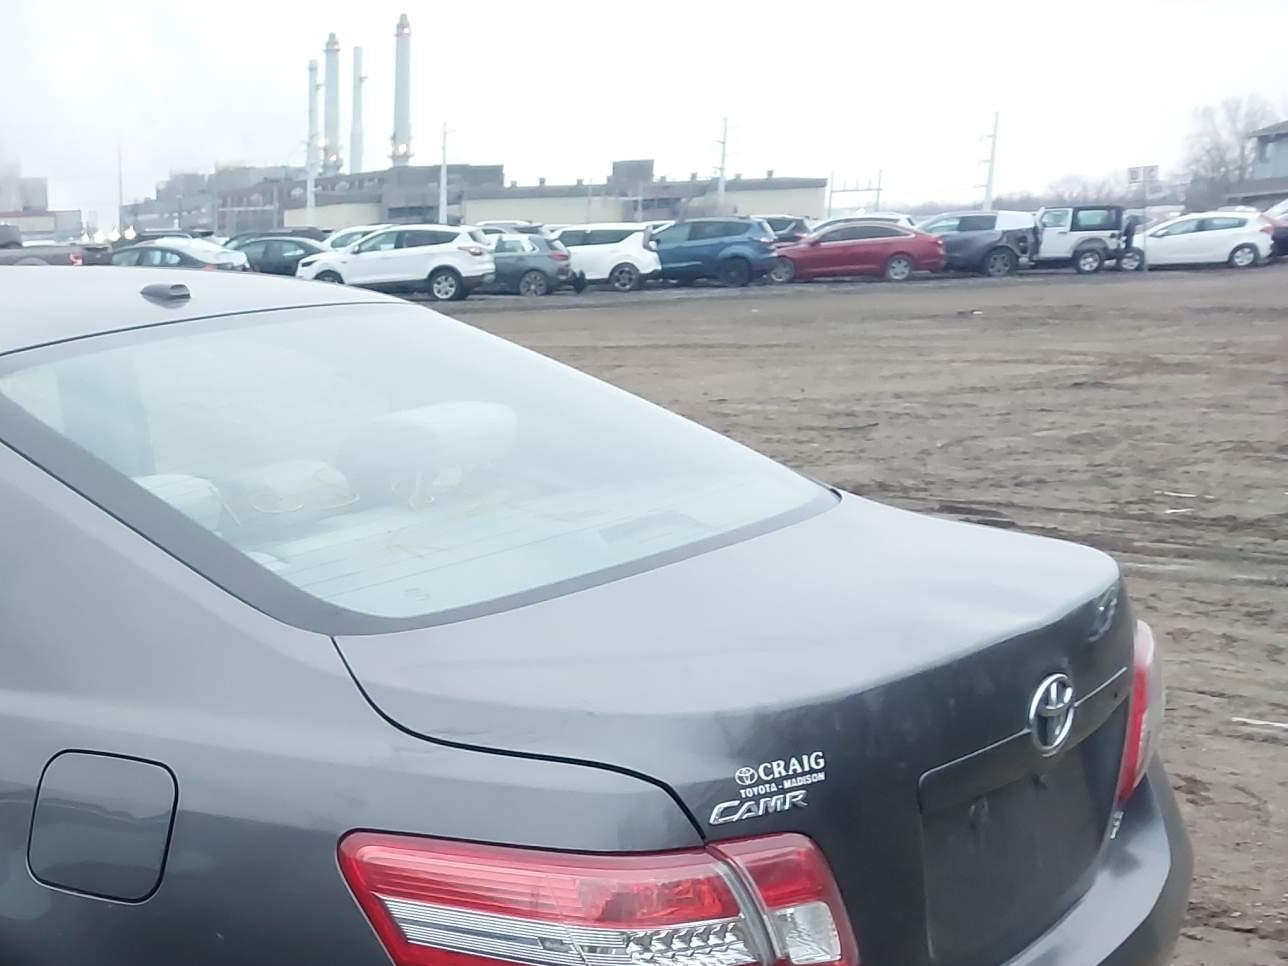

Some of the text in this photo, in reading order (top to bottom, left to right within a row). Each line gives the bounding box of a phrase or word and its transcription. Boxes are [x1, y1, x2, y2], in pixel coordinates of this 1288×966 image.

[758, 752, 825, 781] CRAIG
[739, 783, 778, 799] TOYOTA
[783, 771, 826, 788] MADISON
